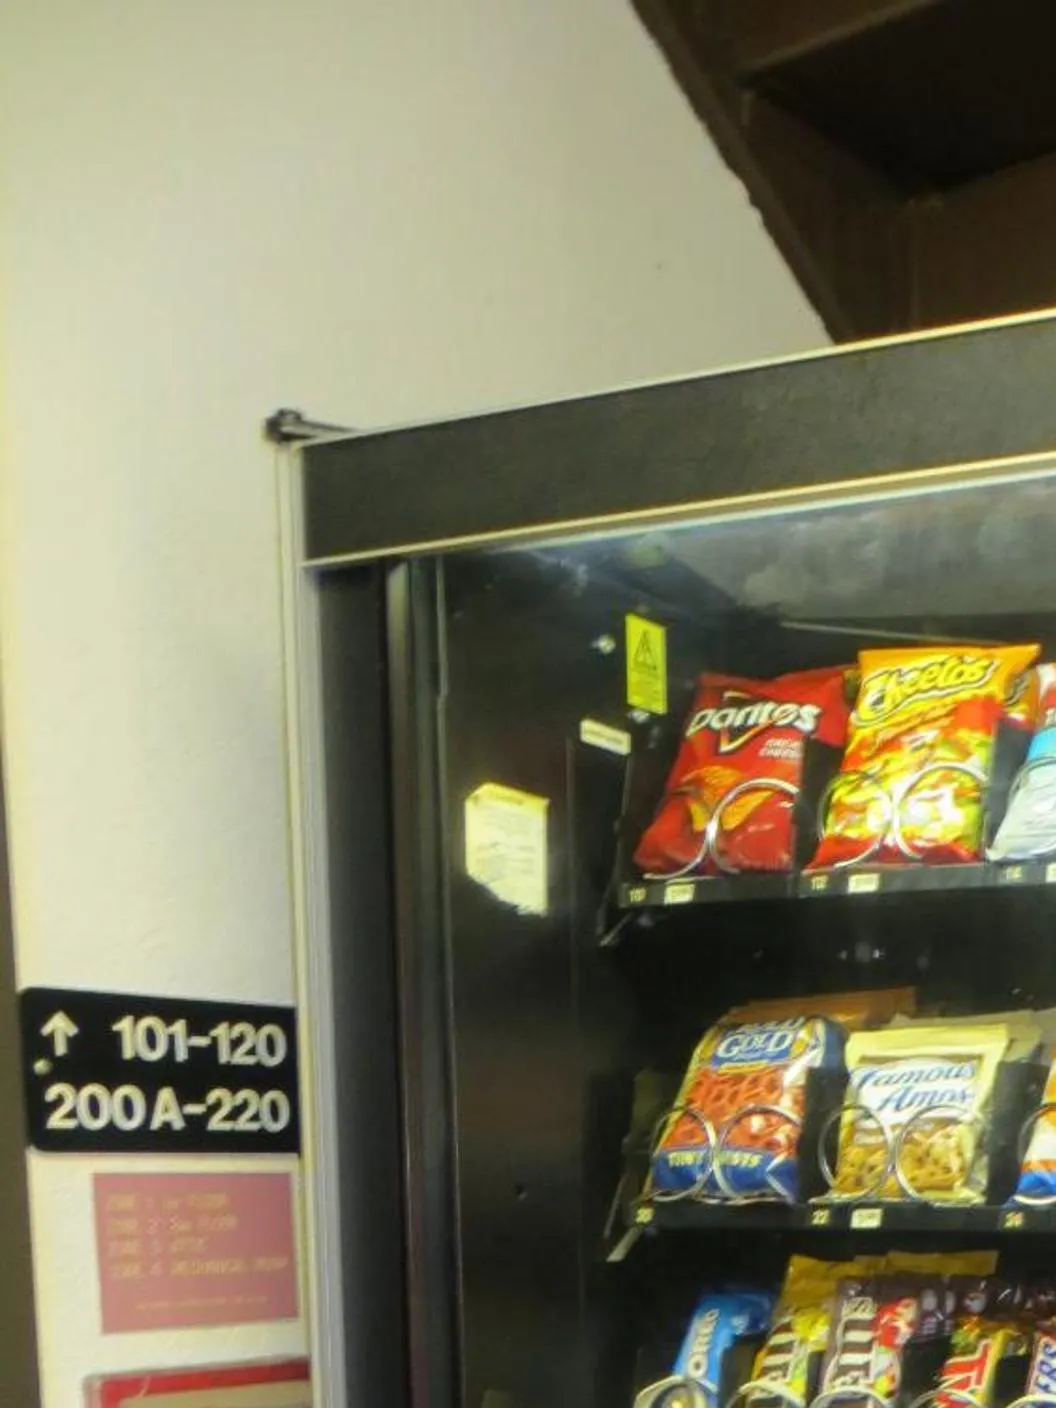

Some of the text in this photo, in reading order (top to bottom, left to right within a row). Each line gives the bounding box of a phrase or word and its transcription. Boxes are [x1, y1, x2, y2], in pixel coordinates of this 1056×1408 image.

[859, 657, 991, 721] Cheetos
[686, 702, 822, 737] Doritos
[112, 1015, 288, 1067] 101-120
[852, 1062, 976, 1088] Famous
[44, 1082, 291, 1133] 200A-220
[879, 1086, 971, 1111] Amos
